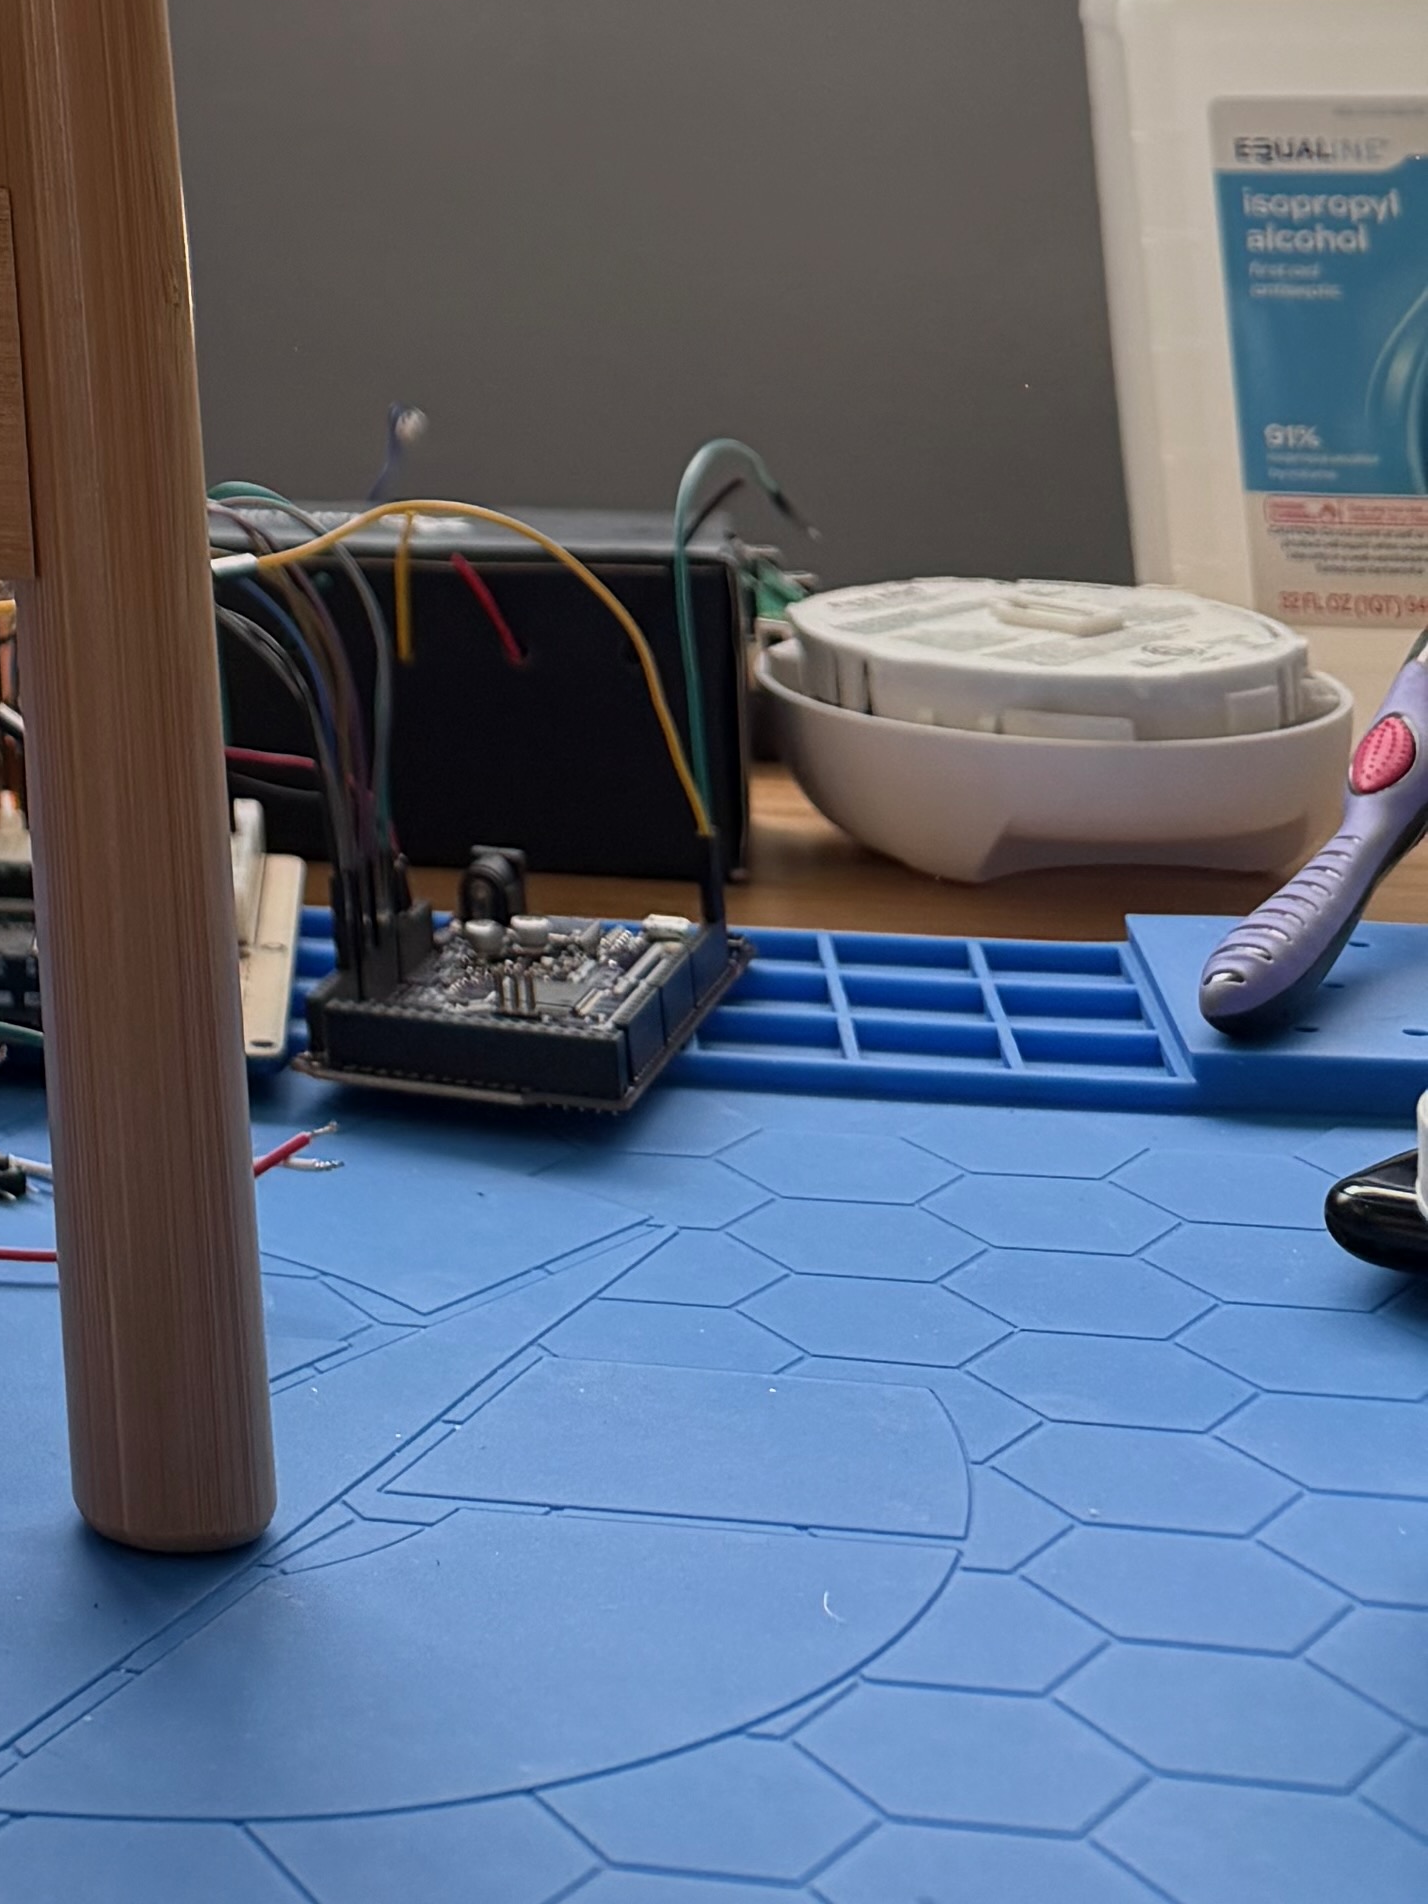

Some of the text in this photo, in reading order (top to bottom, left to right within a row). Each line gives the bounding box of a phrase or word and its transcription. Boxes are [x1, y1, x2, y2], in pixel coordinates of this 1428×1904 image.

[1242, 187, 1401, 223] isopropyl
[1246, 223, 1369, 253] alcohol
[1264, 422, 1322, 449] 91%
